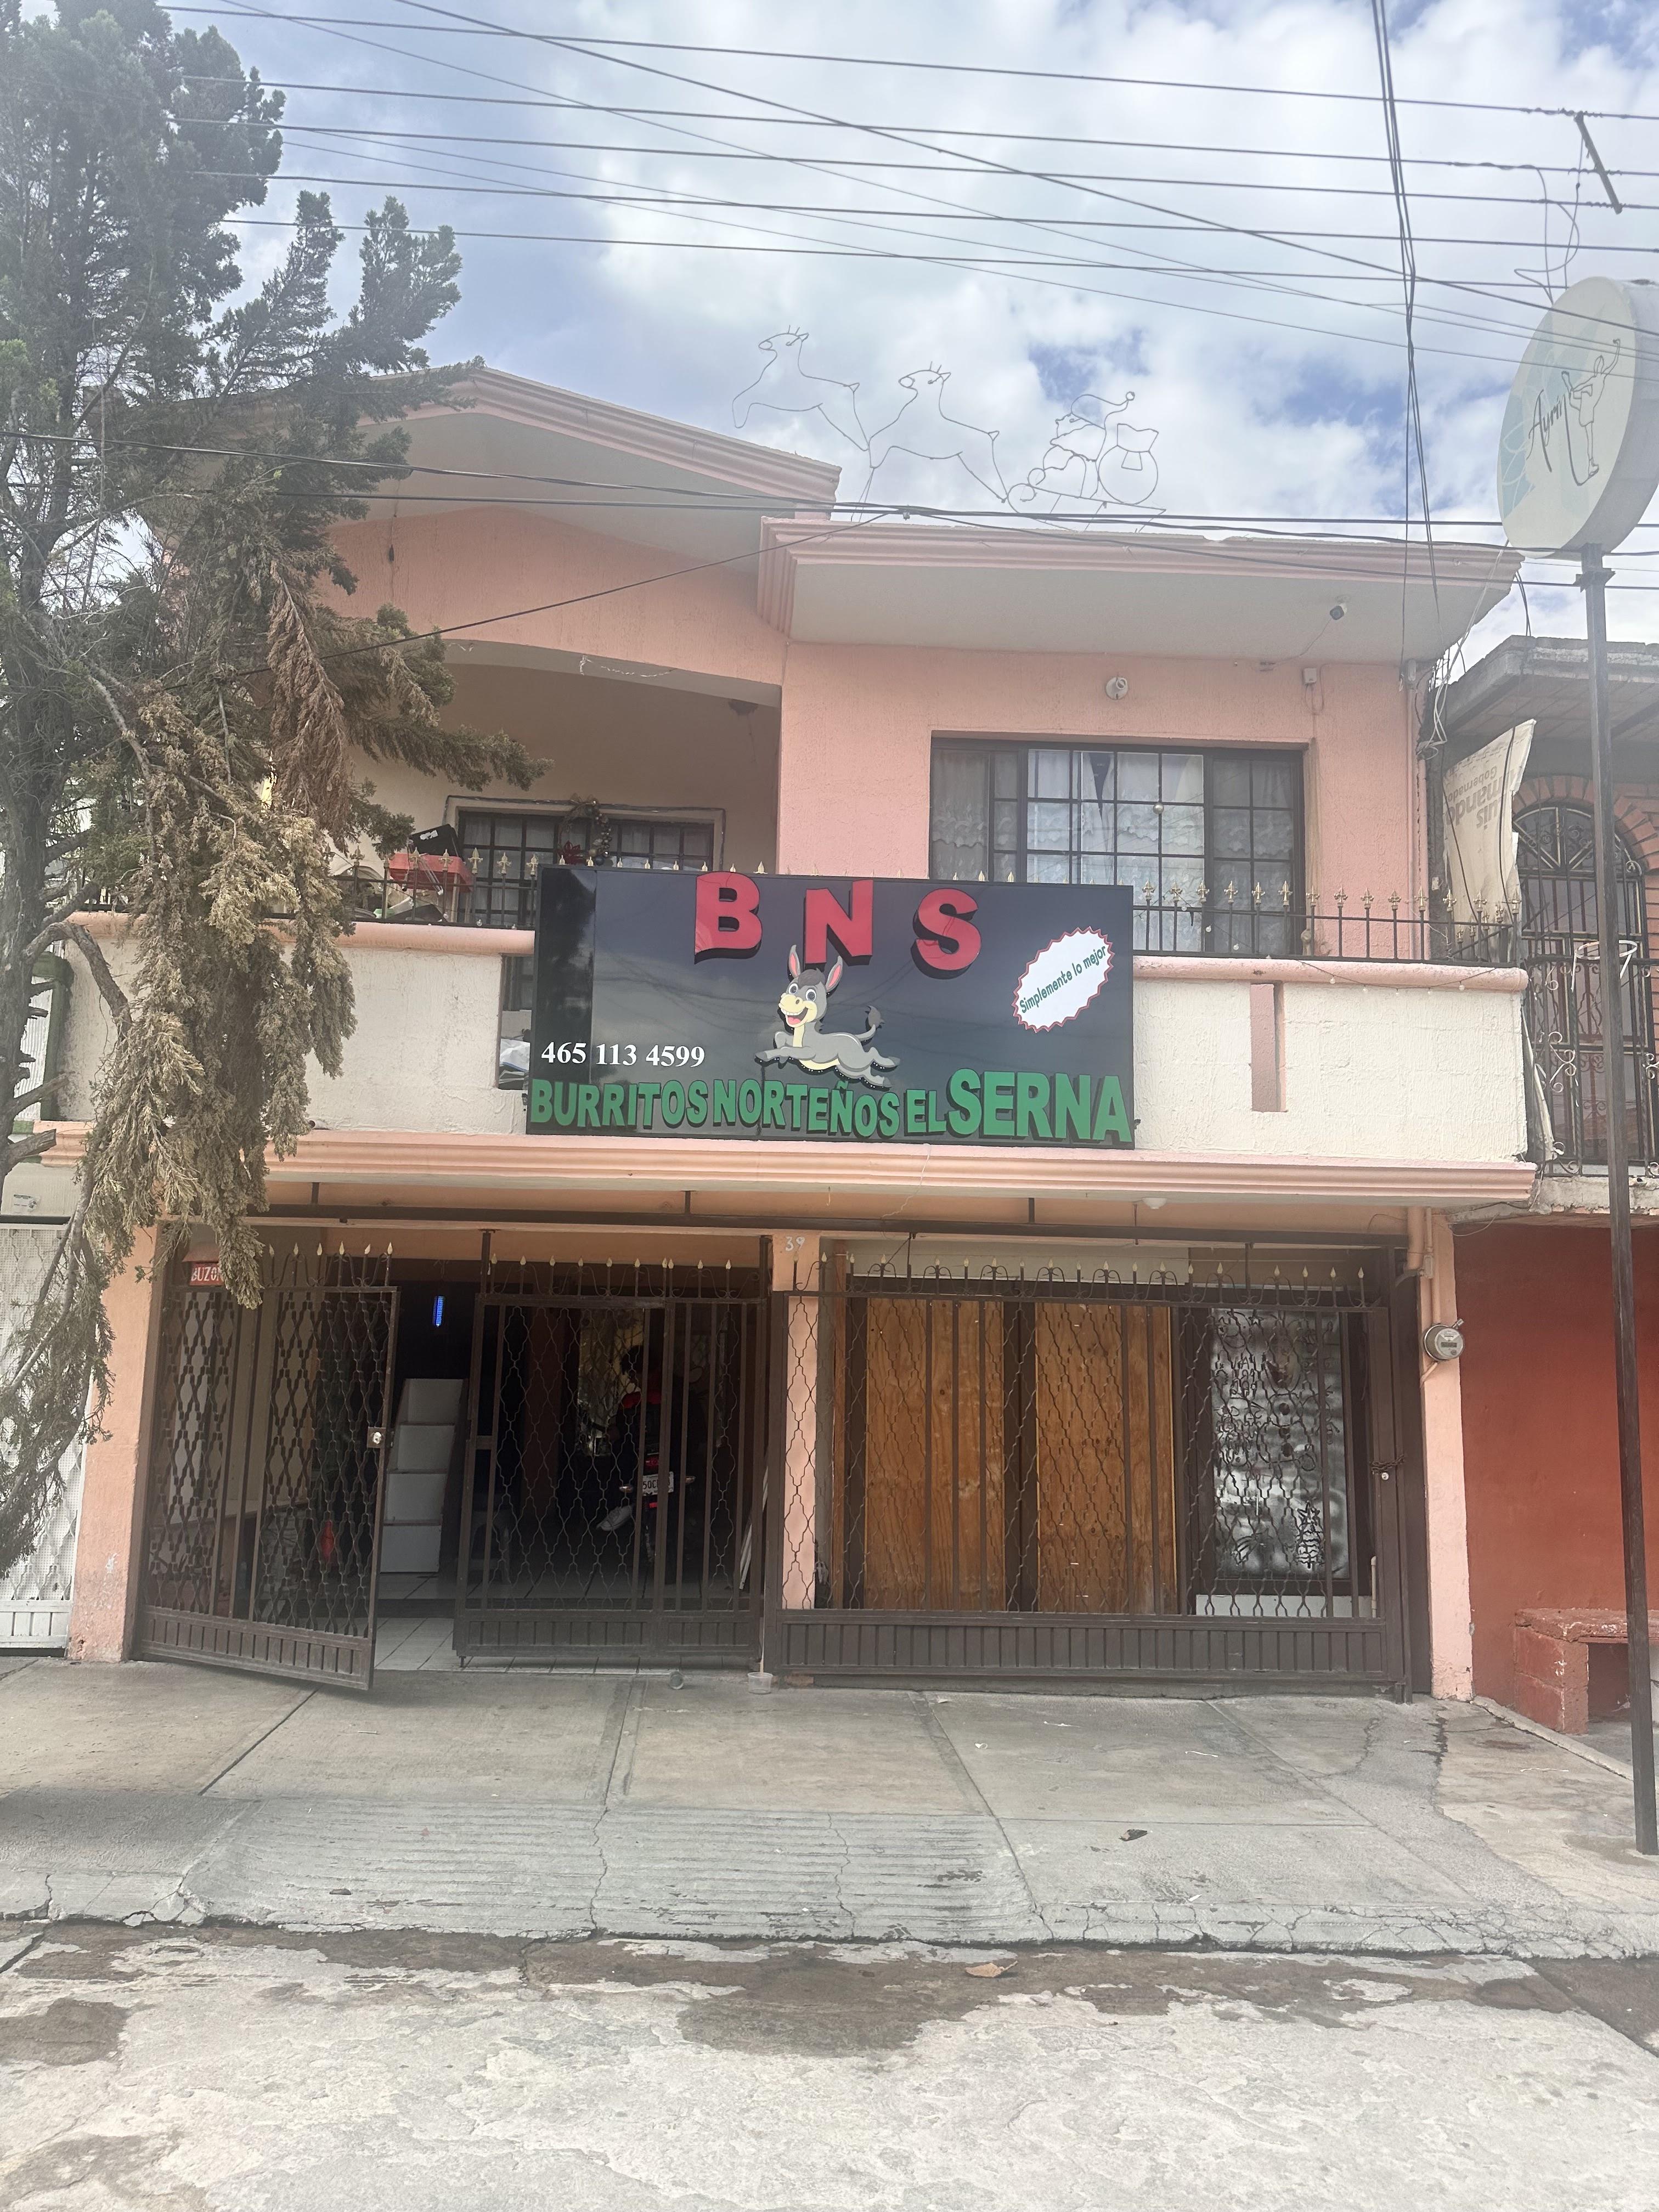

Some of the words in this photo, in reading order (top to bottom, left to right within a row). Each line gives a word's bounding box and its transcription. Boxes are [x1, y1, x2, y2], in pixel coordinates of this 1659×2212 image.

[1445, 775, 1504, 826] mando
[1446, 765, 1497, 803] Gobernado
[1476, 799, 1499, 830] uis
[1019, 970, 1073, 1013] Simplemente
[1071, 962, 1082, 977] lo
[1082, 946, 1106, 969] mejor
[541, 1041, 587, 1064] 465
[596, 1043, 637, 1066] 113
[646, 1045, 706, 1068] 4599
[530, 1078, 709, 1128] BURRITOS
[713, 1078, 900, 1137] NORTEÑOS
[906, 1089, 947, 1133] EL
[948, 1067, 1133, 1143] SERNA
[785, 1235, 805, 1251] 39
